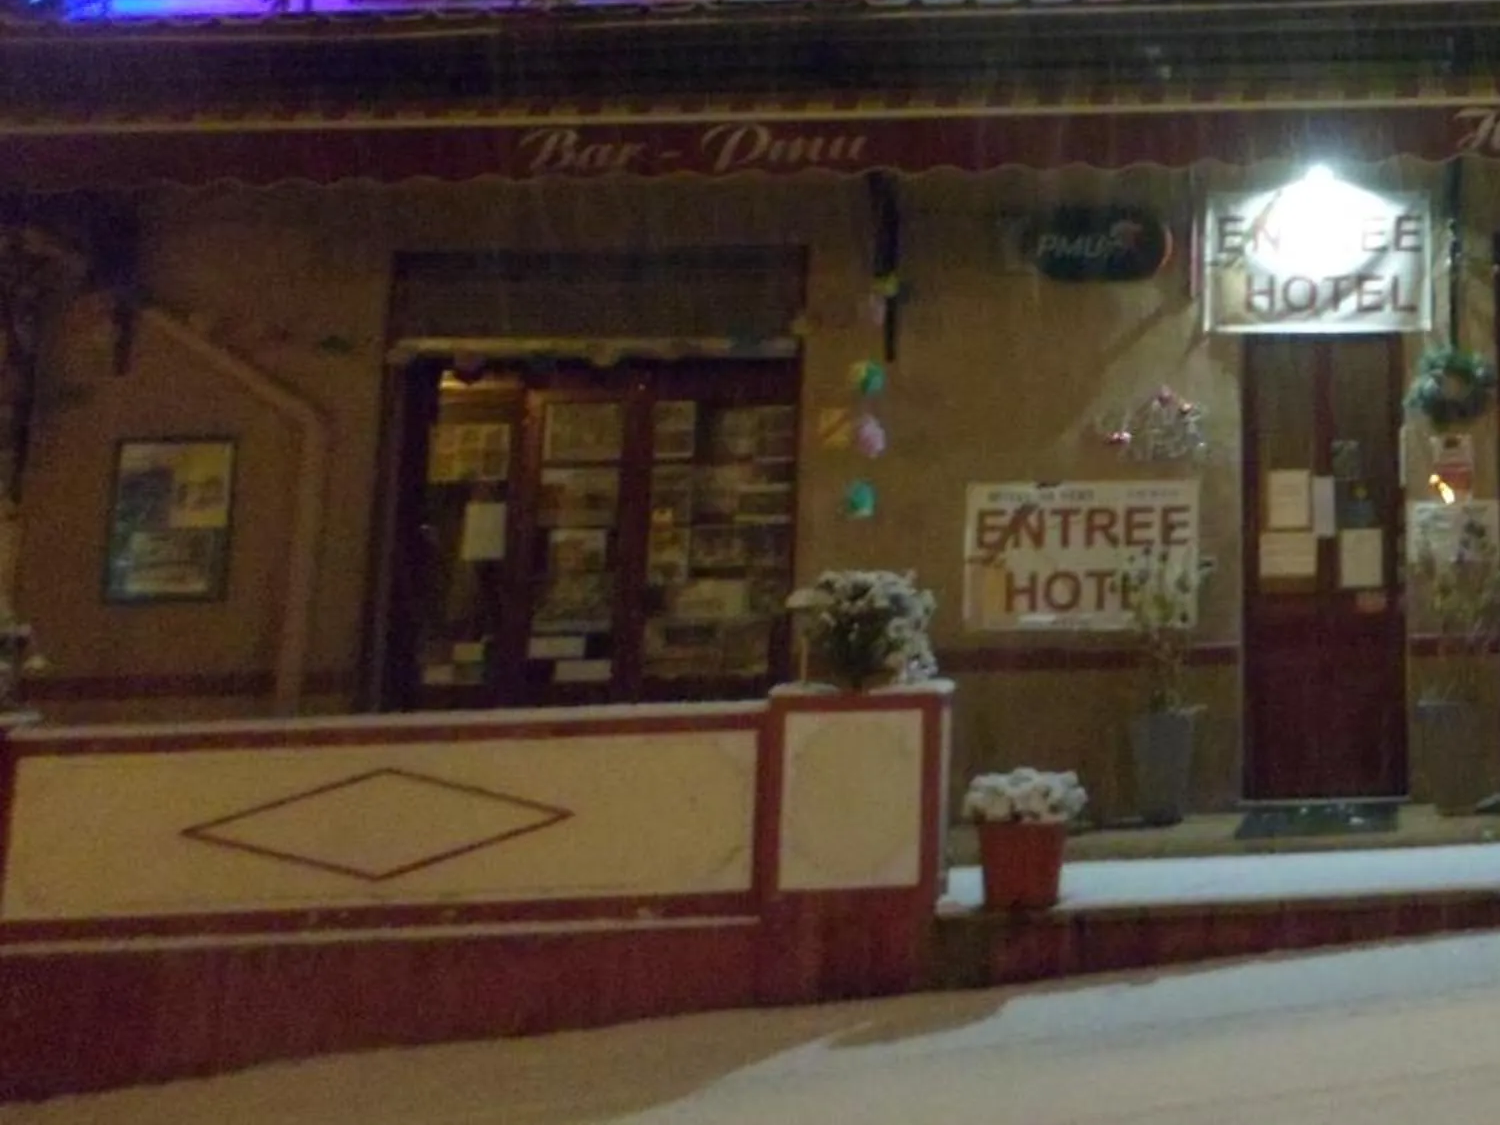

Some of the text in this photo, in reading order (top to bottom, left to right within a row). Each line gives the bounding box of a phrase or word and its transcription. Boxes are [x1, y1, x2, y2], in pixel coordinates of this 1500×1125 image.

[519, 127, 647, 171] Bar
[1218, 214, 1423, 253] ENEE
[1245, 273, 1418, 314] HOTEL
[977, 505, 1191, 549] ENTREE
[1005, 571, 1180, 612] HOT
